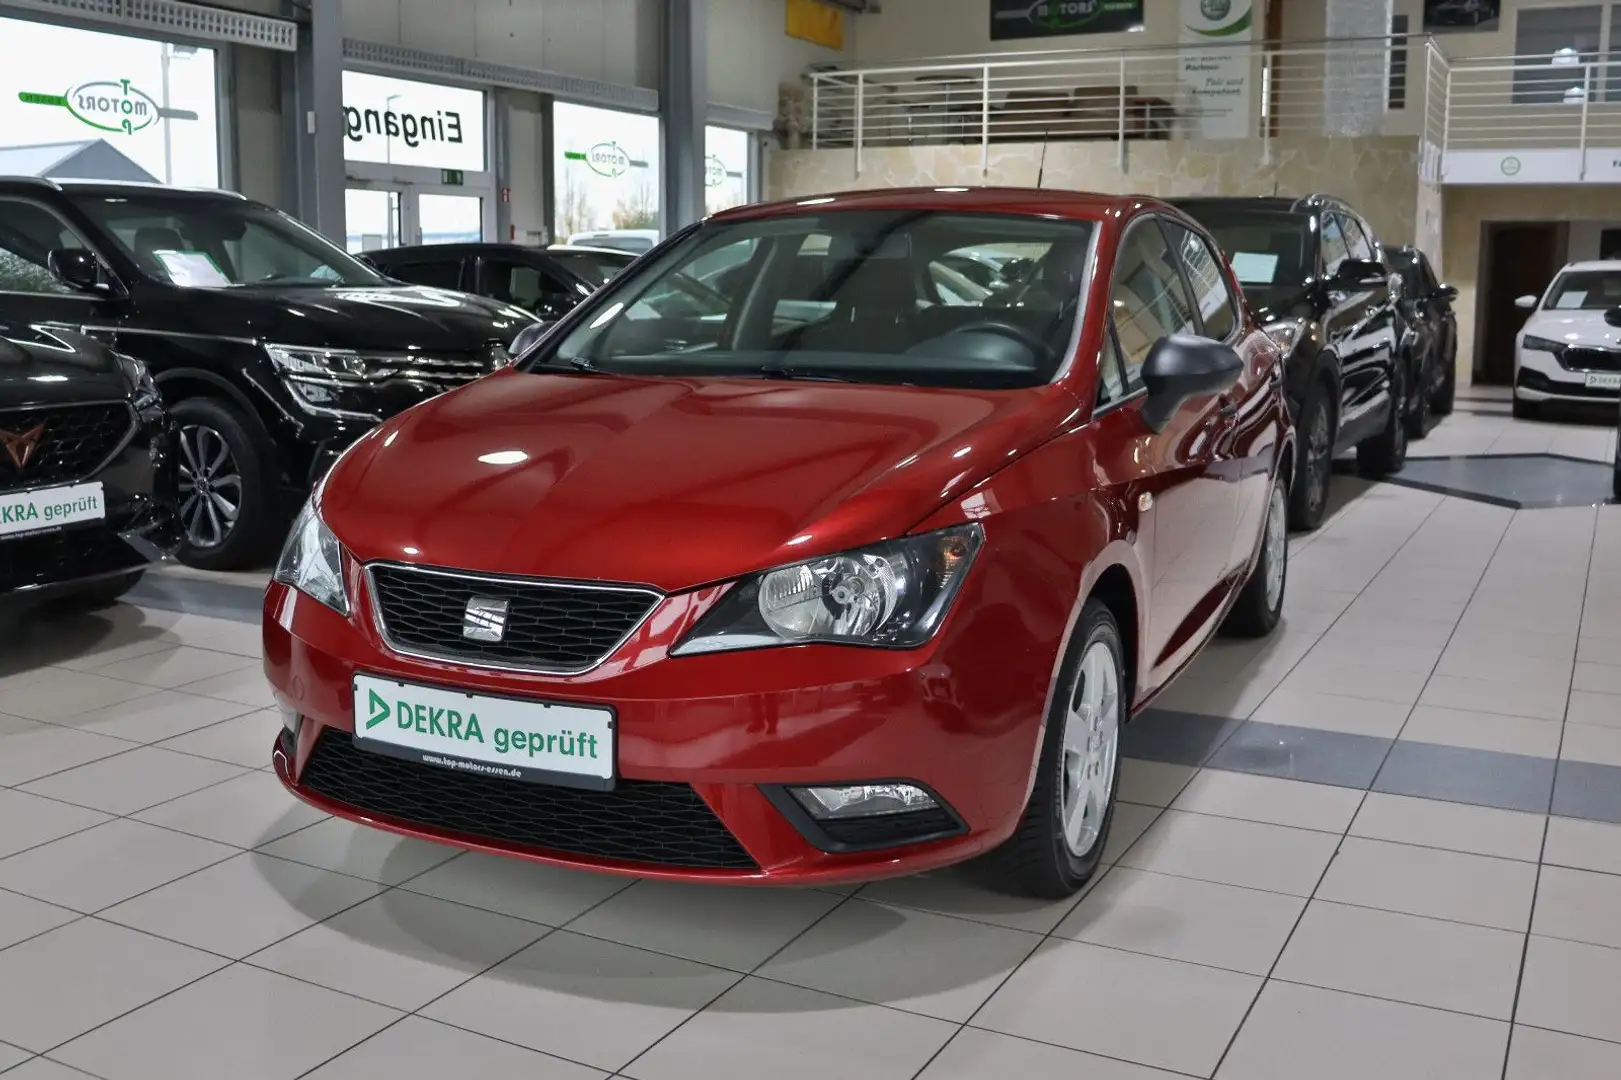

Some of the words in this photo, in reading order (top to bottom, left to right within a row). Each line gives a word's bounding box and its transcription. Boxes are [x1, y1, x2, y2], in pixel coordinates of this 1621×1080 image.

[0, 501, 39, 524] KRA
[44, 495, 98, 521] geprüft
[397, 700, 485, 743] DEKRA
[494, 729, 598, 759] geprüft
[422, 754, 522, 778] www.top-motors-essen.de
